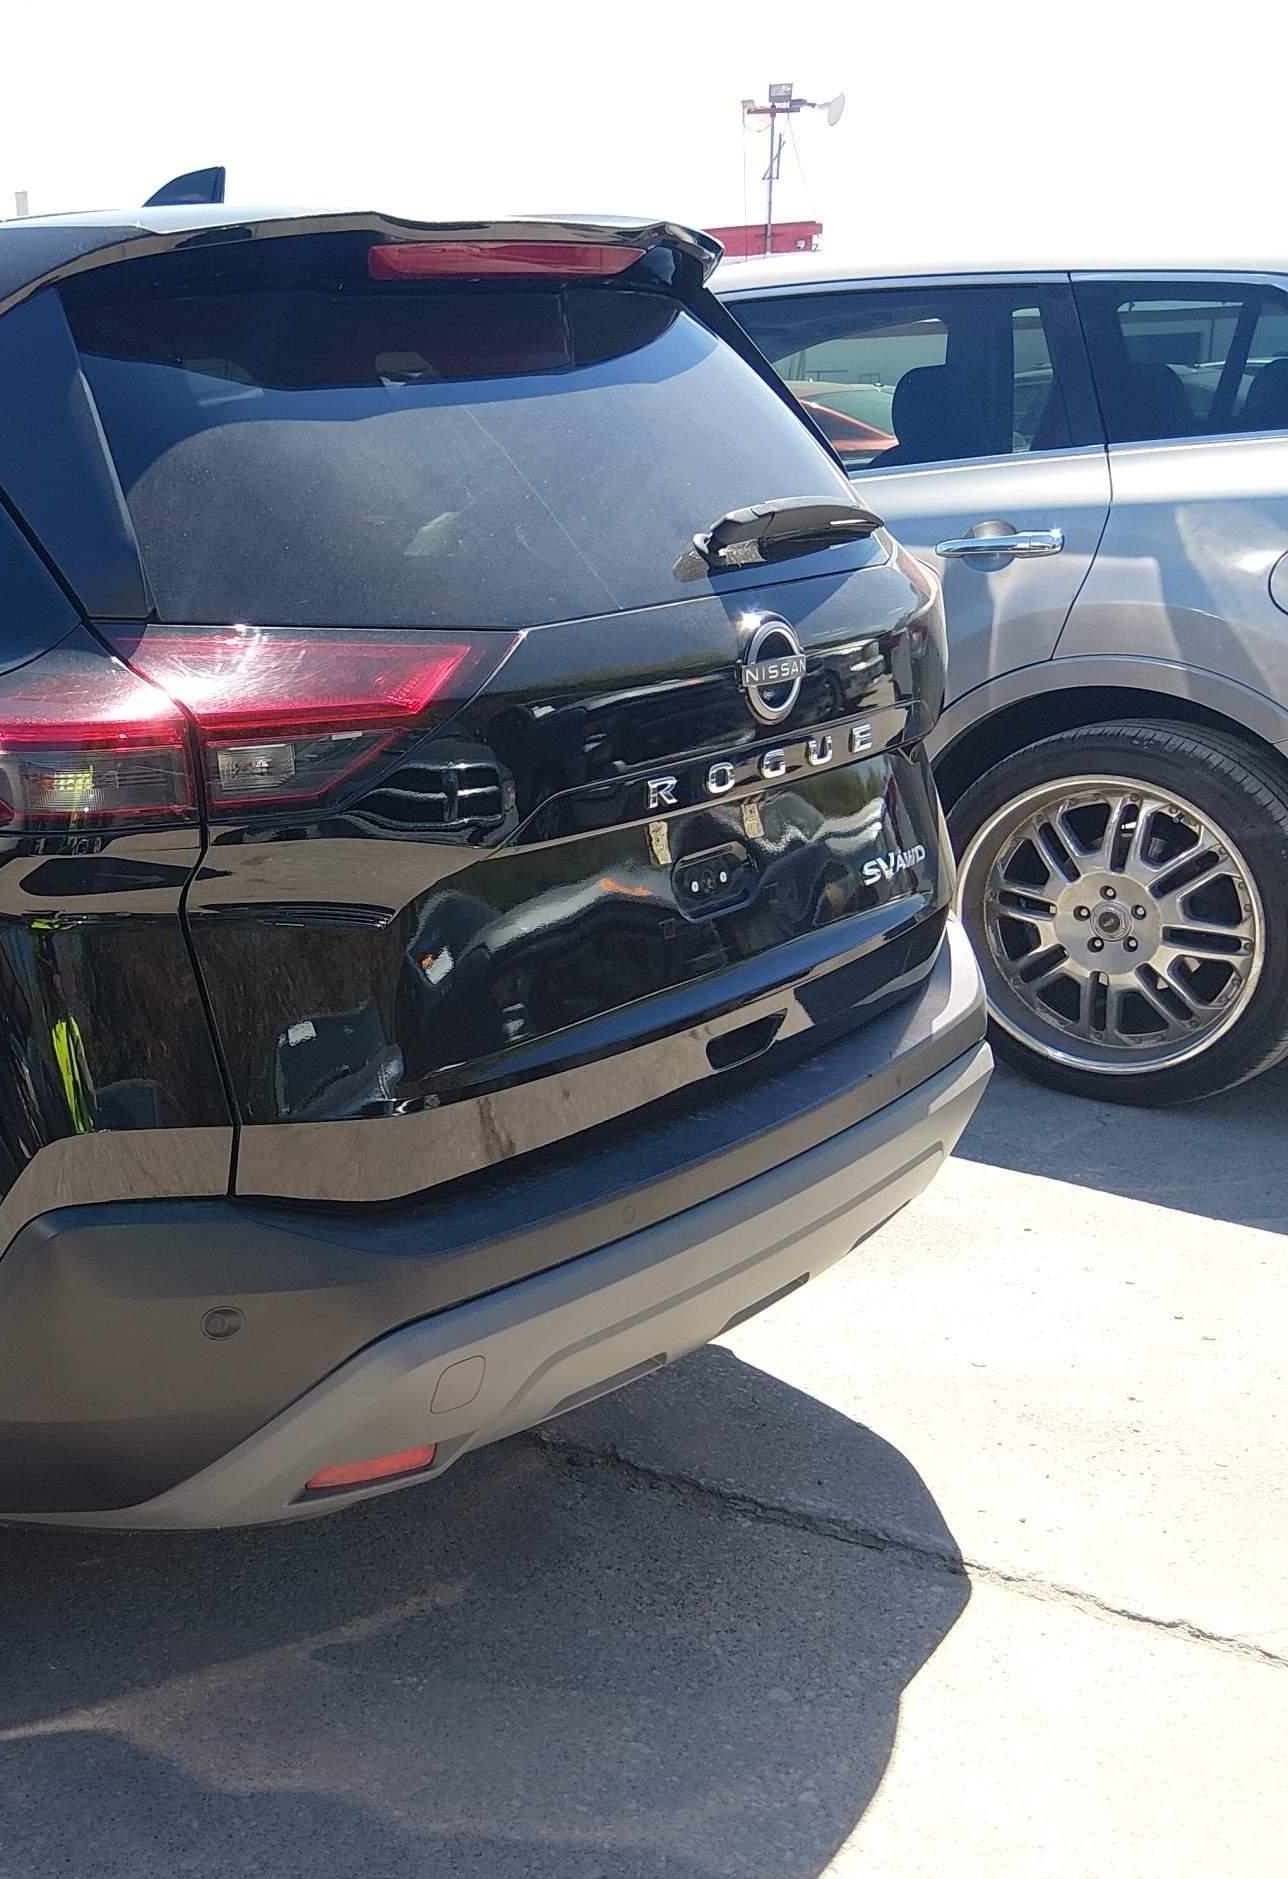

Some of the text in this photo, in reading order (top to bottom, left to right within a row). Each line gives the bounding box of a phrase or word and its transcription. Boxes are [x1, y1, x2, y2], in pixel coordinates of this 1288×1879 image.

[745, 659, 806, 683] NISSAN
[646, 724, 873, 809] ROGUE
[862, 844, 926, 886] SV AWD
